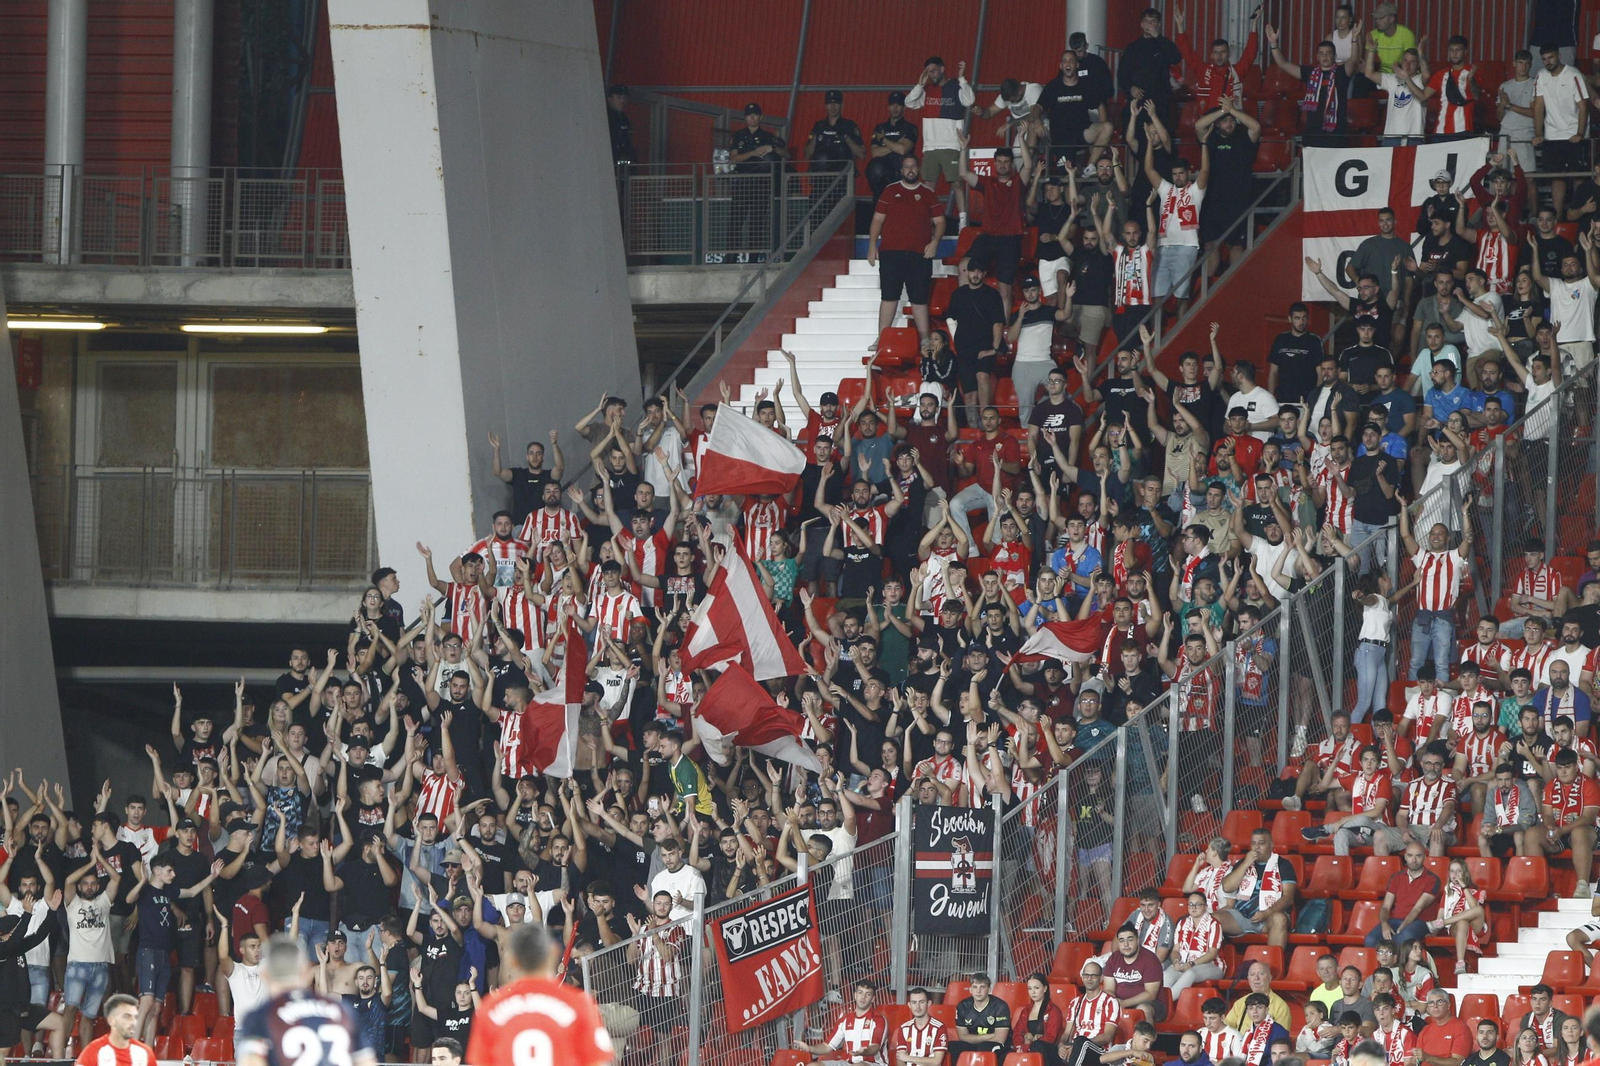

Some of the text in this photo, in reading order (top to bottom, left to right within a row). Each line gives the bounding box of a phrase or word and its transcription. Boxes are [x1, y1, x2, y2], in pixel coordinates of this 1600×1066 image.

[973, 166, 992, 177] 141
[1335, 159, 1369, 197] G
[929, 806, 986, 846] Sección
[929, 882, 990, 919] Juvenil
